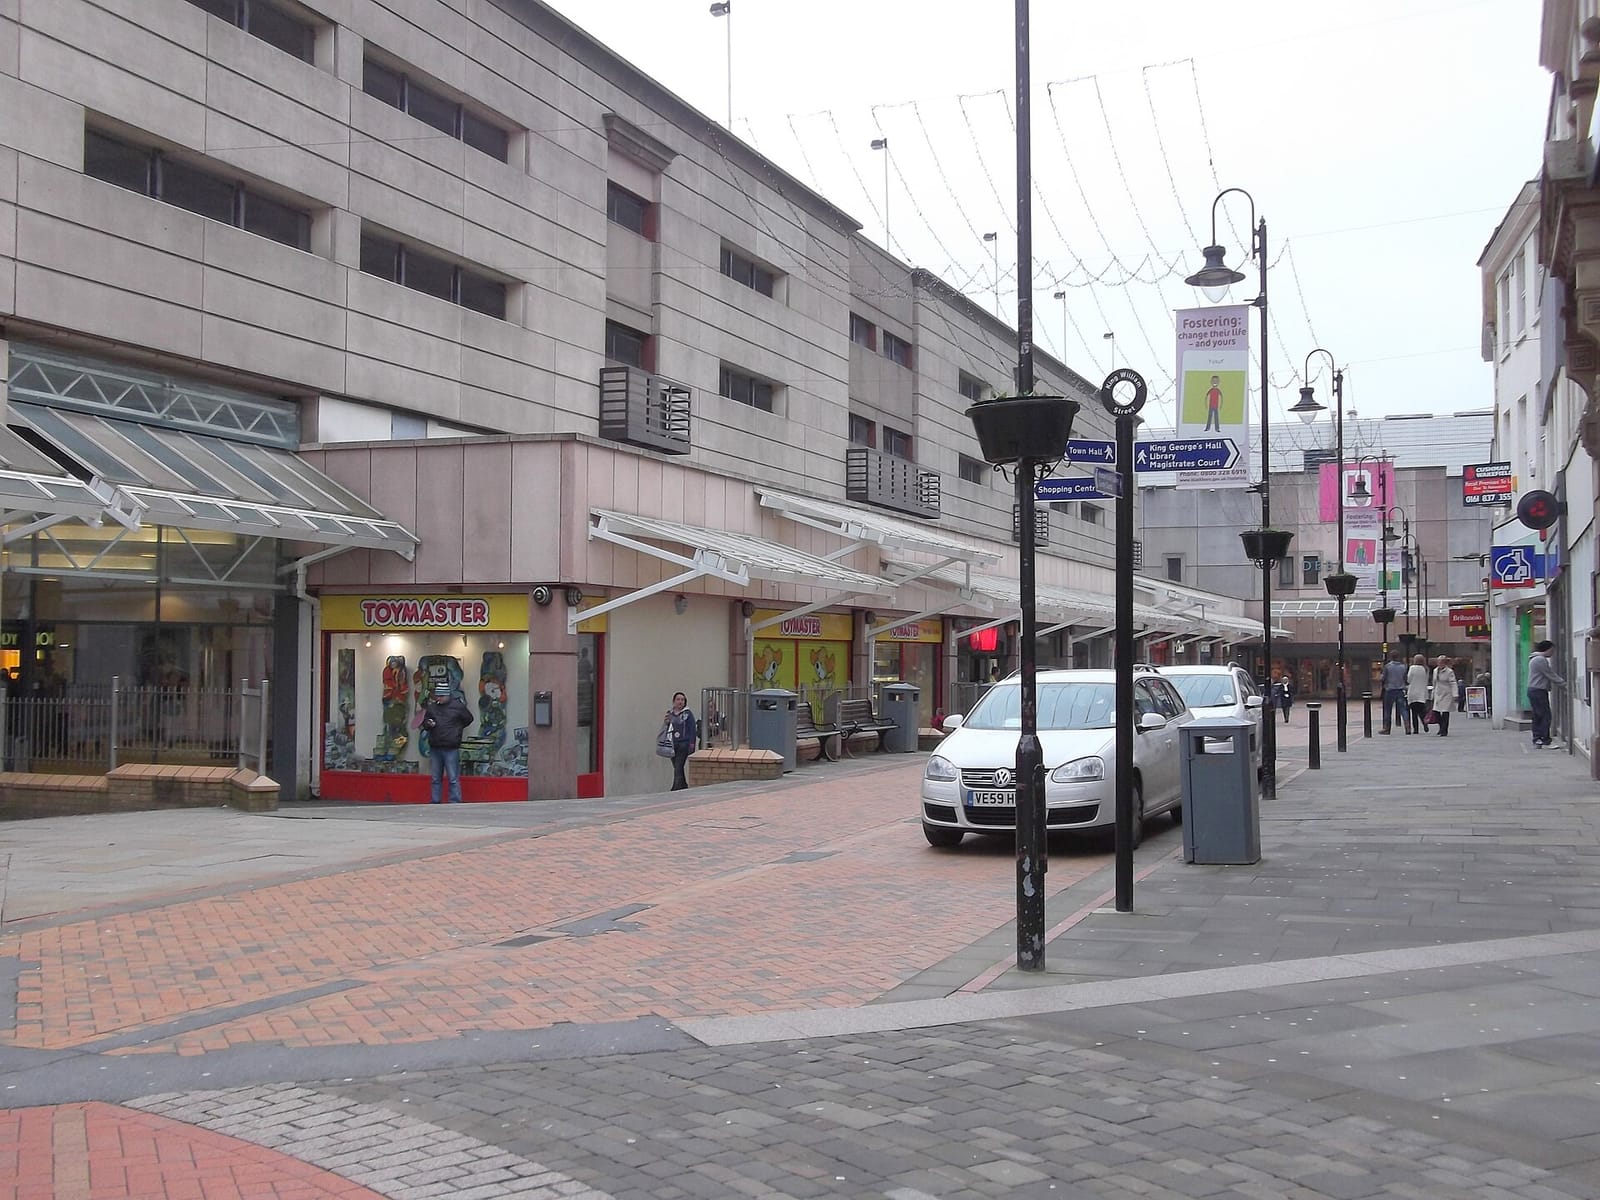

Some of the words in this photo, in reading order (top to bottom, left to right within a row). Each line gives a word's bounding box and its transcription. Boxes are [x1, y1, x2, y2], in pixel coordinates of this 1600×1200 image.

[1183, 316, 1242, 329] Fostering:
[1178, 332, 1208, 340] change
[1210, 329, 1231, 338] their
[1231, 328, 1247, 336] life
[1213, 338, 1236, 348] yours
[1069, 446, 1087, 454] Town
[1088, 447, 1103, 456] Hall
[1149, 444, 1167, 452] King
[1168, 442, 1203, 451] George's
[1205, 441, 1222, 449] Hall
[1149, 460, 1196, 469] Magistrates
[1197, 458, 1220, 467] Court
[1038, 485, 1073, 494] Shopping
[1074, 484, 1096, 492] Centr
[362, 601, 487, 624] TOYMASTER
[975, 793, 1004, 804] VE59
